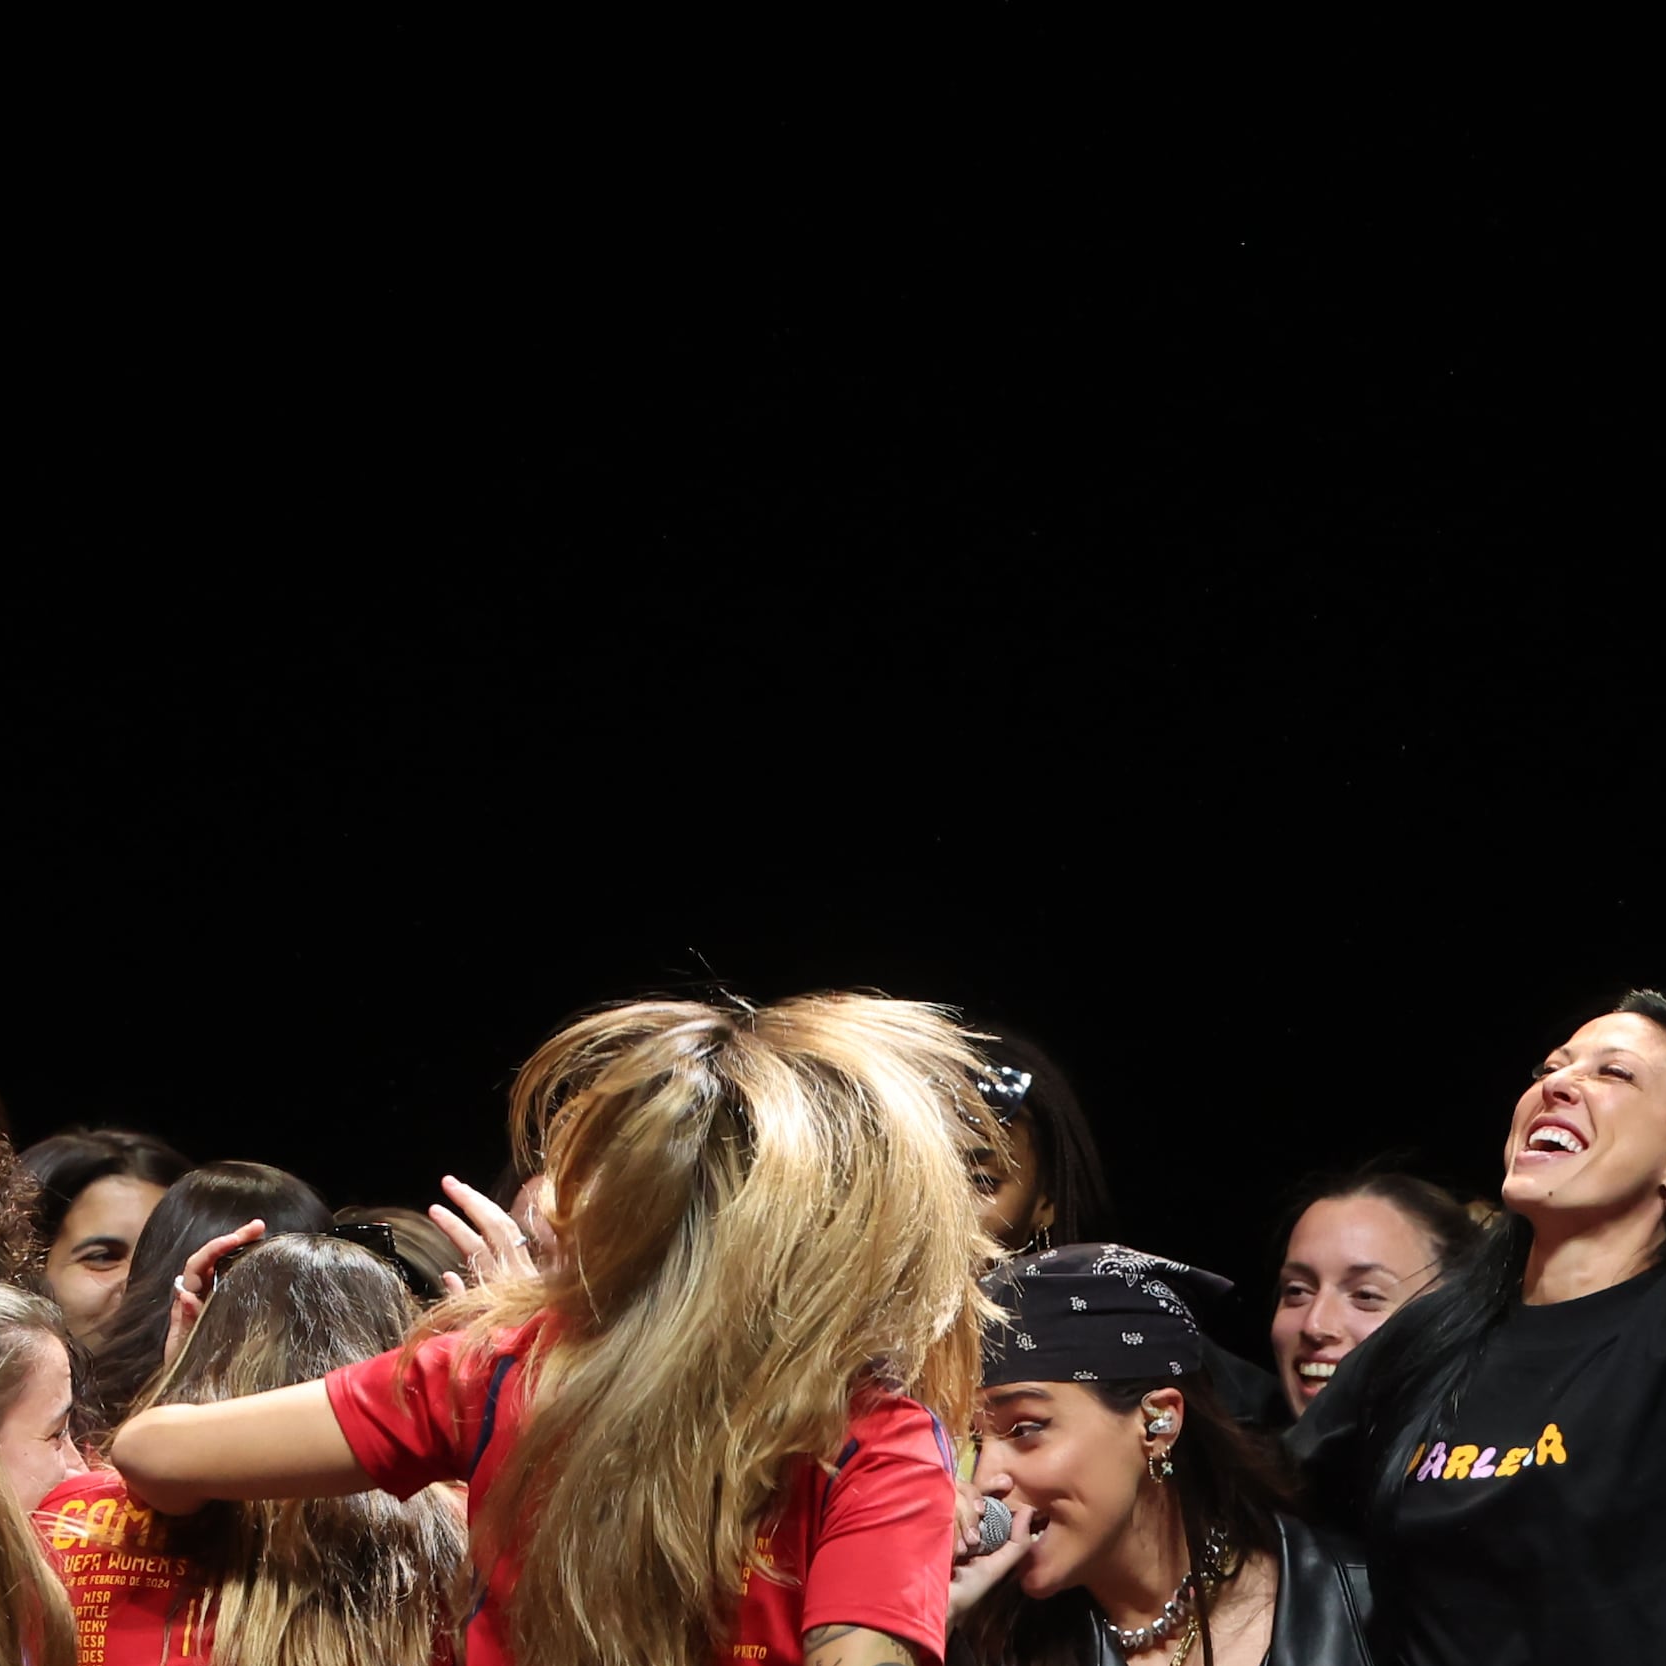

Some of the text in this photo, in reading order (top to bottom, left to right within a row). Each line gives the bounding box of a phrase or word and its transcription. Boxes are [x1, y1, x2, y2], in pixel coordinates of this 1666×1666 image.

[52, 1498, 155, 1550] CAM
[64, 1553, 102, 1574] UEFA
[76, 1575, 87, 1587] DE
[90, 1574, 126, 1587] FEBRERO
[129, 1575, 141, 1588] DE
[82, 1591, 111, 1604] MISA
[77, 1634, 105, 1648] RESA
